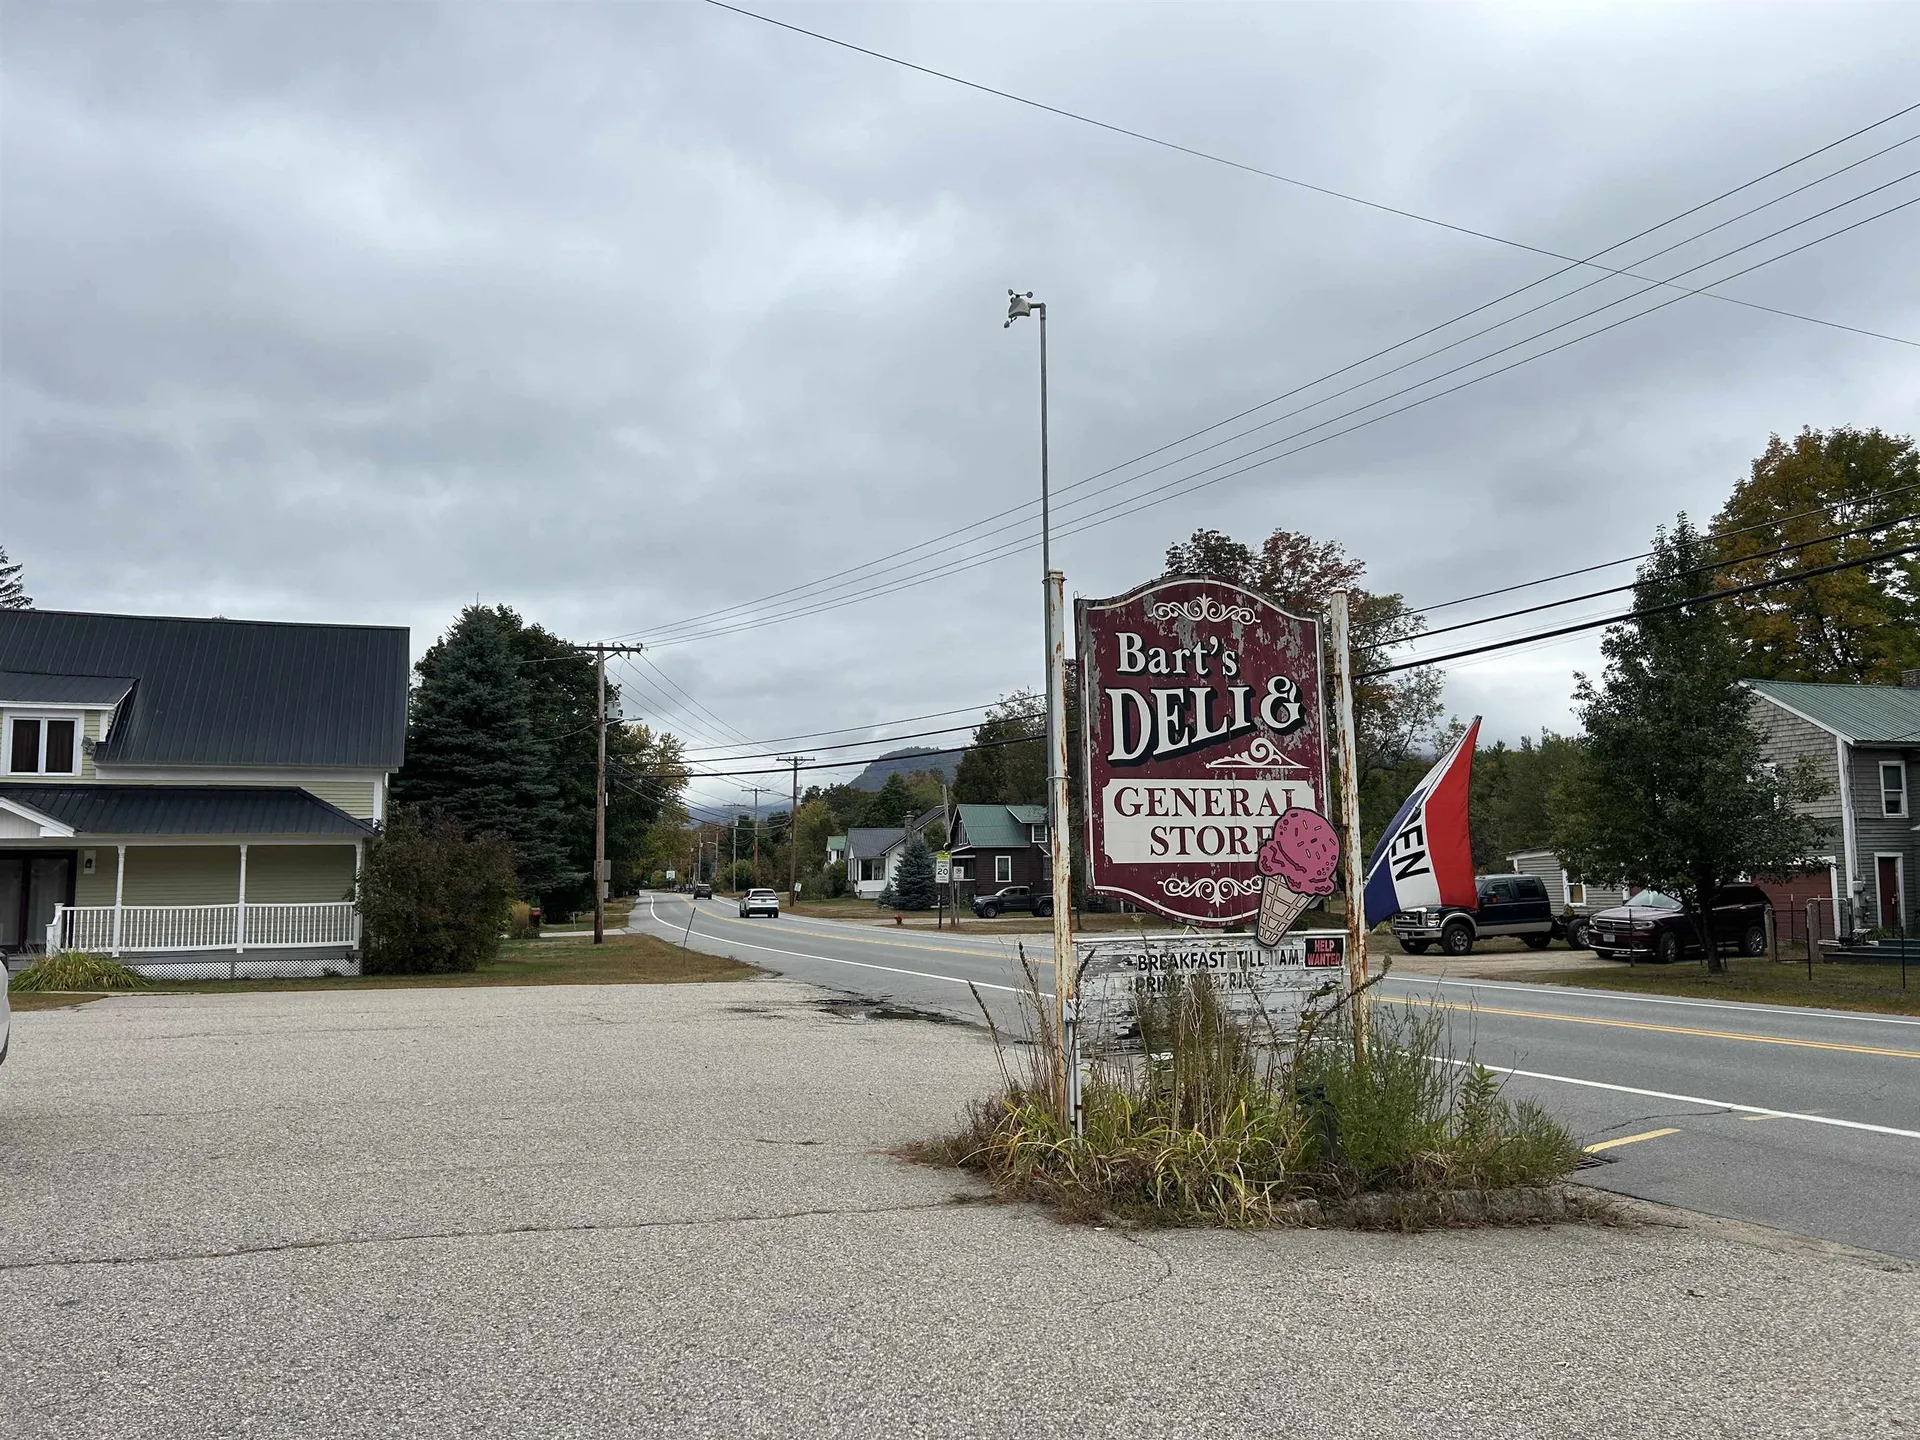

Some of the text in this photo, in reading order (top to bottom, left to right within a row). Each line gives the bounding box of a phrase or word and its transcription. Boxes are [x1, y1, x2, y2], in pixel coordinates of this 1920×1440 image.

[1115, 632, 1239, 676] Bart's
[1105, 675, 1300, 762] DELI &
[937, 868, 949, 876] 20
[1314, 939, 1335, 952] HELP
[1137, 951, 1227, 971] BREAKFAST
[1279, 949, 1299, 966] AM
[1307, 952, 1341, 966] WANTED
